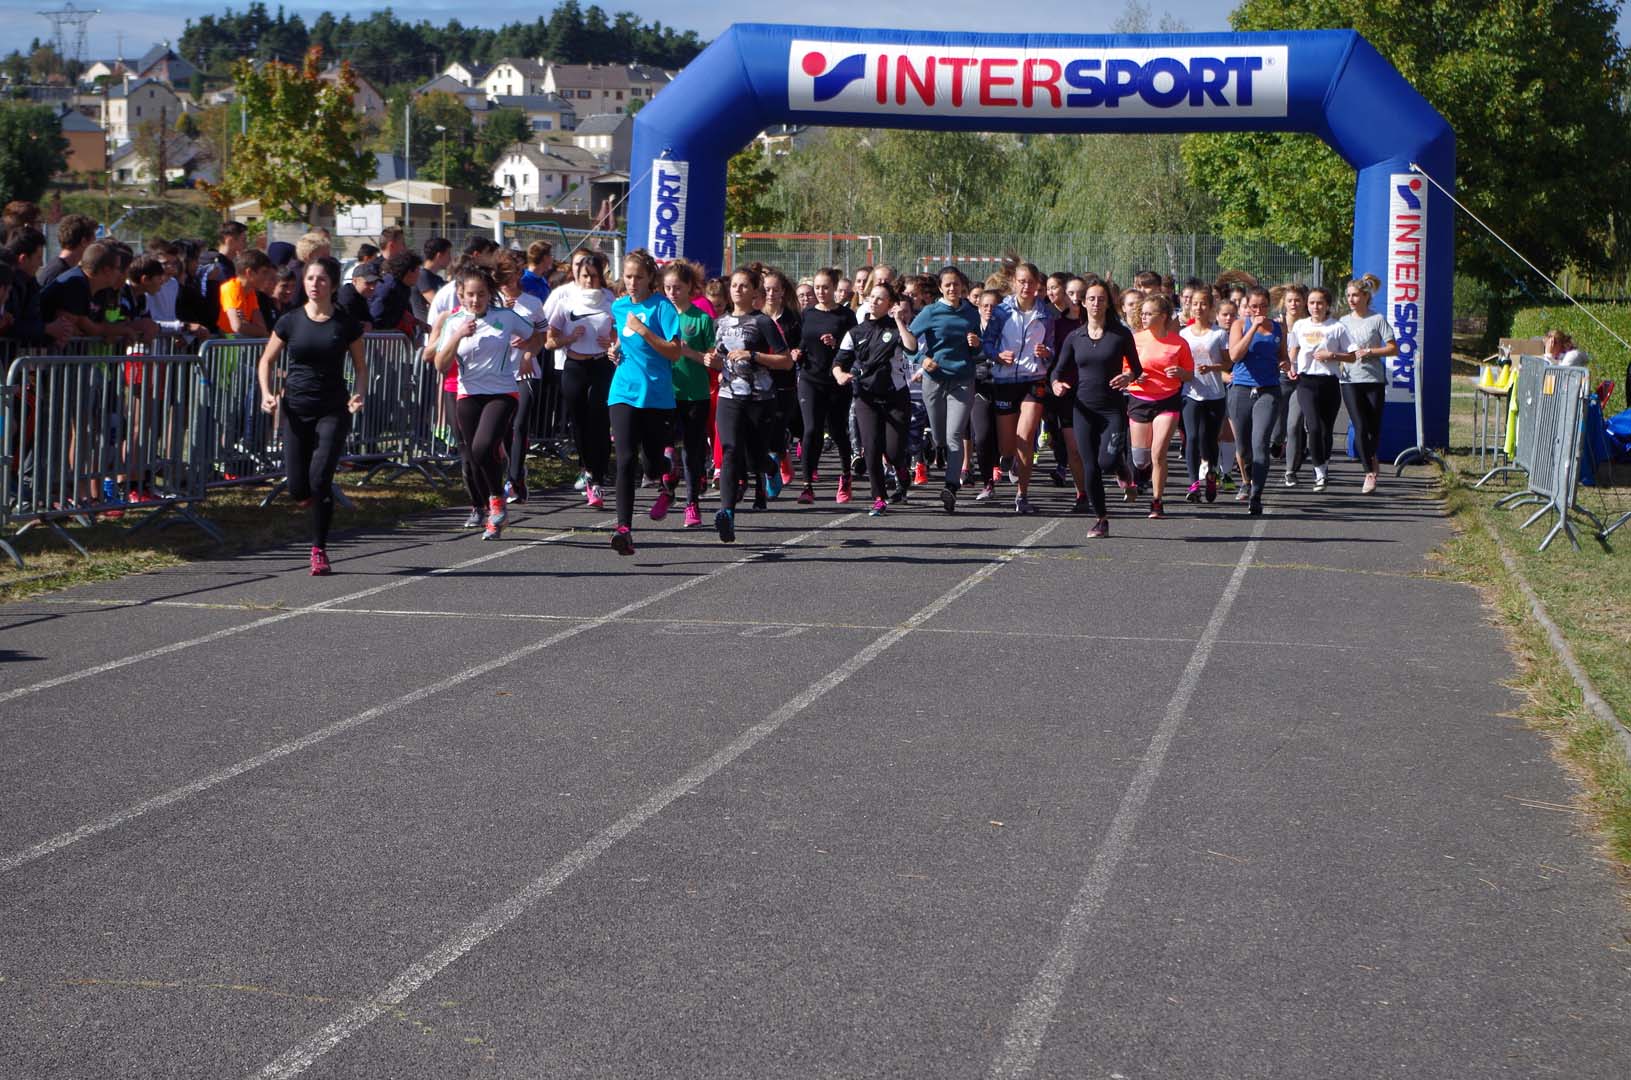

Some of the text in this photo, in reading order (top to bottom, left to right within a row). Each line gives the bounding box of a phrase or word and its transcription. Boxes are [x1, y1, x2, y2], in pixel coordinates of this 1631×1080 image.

[876, 54, 1263, 108] INTERSPORT
[654, 169, 681, 264] SPORT
[1392, 214, 1422, 394] INTERSPORT
